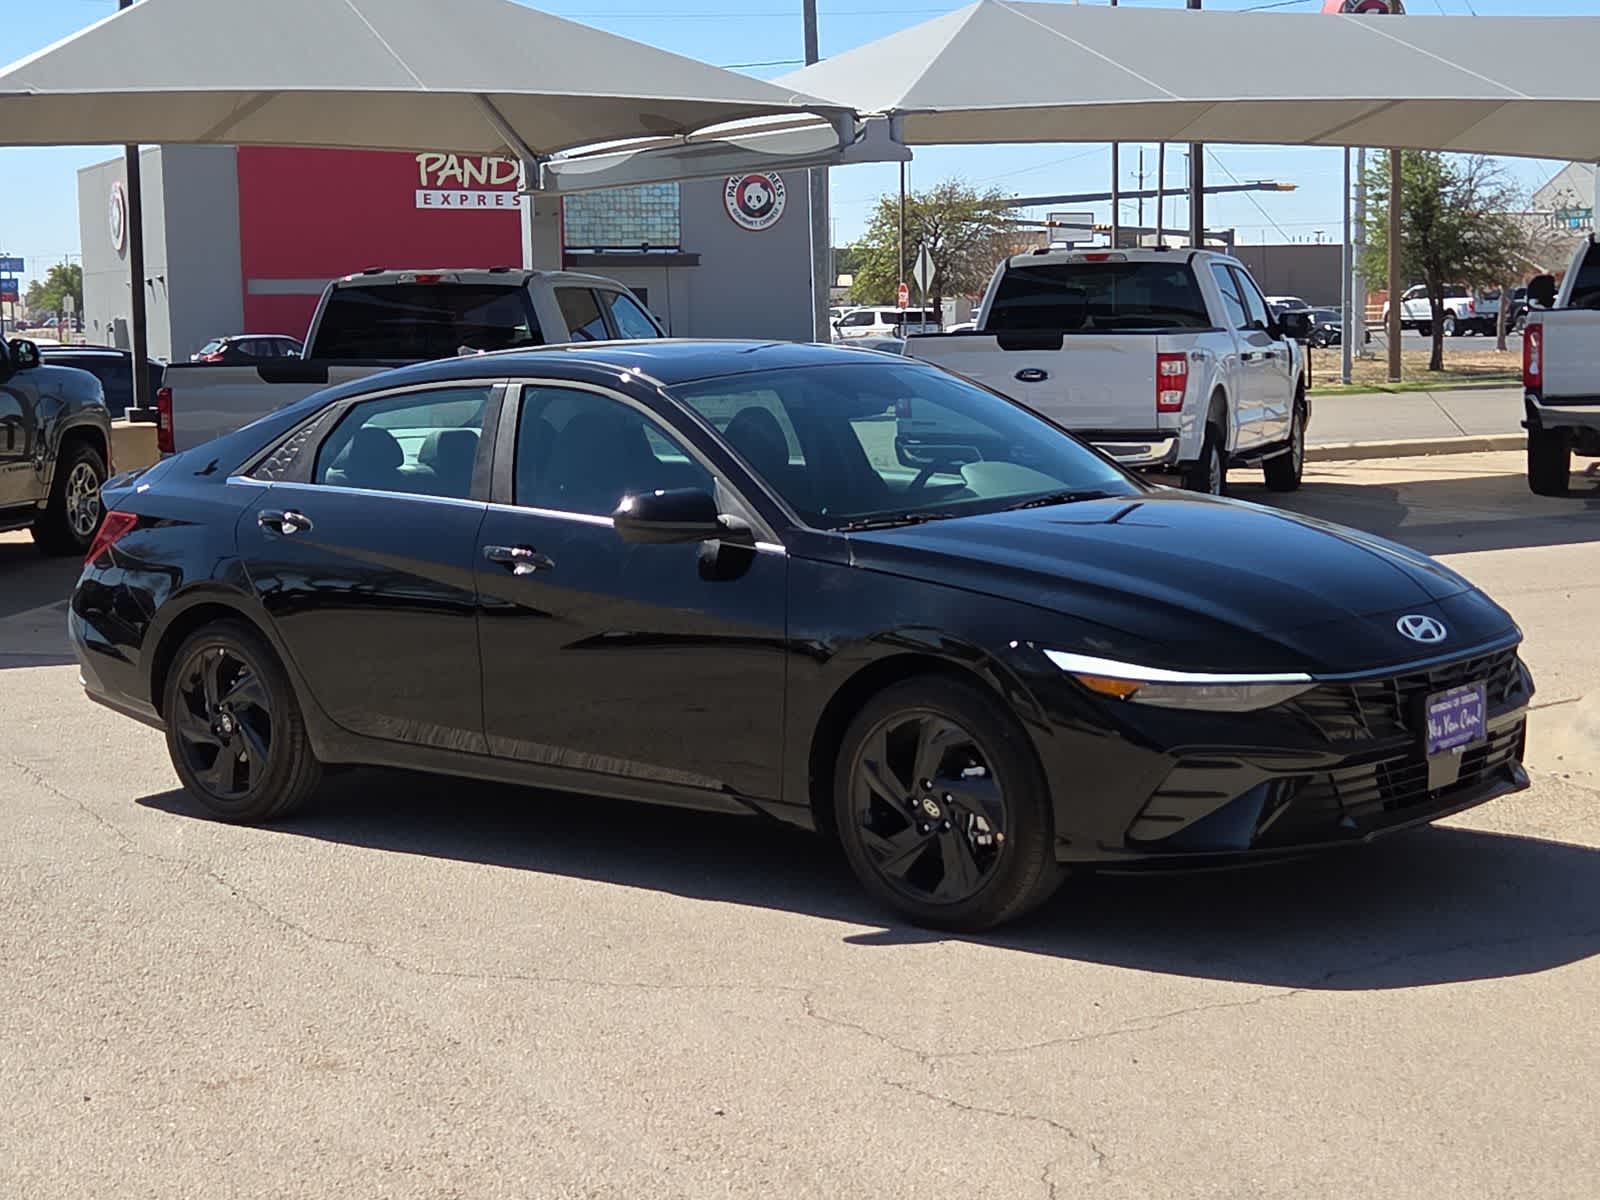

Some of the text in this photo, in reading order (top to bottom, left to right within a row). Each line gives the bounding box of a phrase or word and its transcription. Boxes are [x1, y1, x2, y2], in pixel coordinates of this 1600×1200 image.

[415, 152, 519, 188] PAND
[727, 171, 784, 198] PAN RESS
[423, 192, 521, 206] EXPRES
